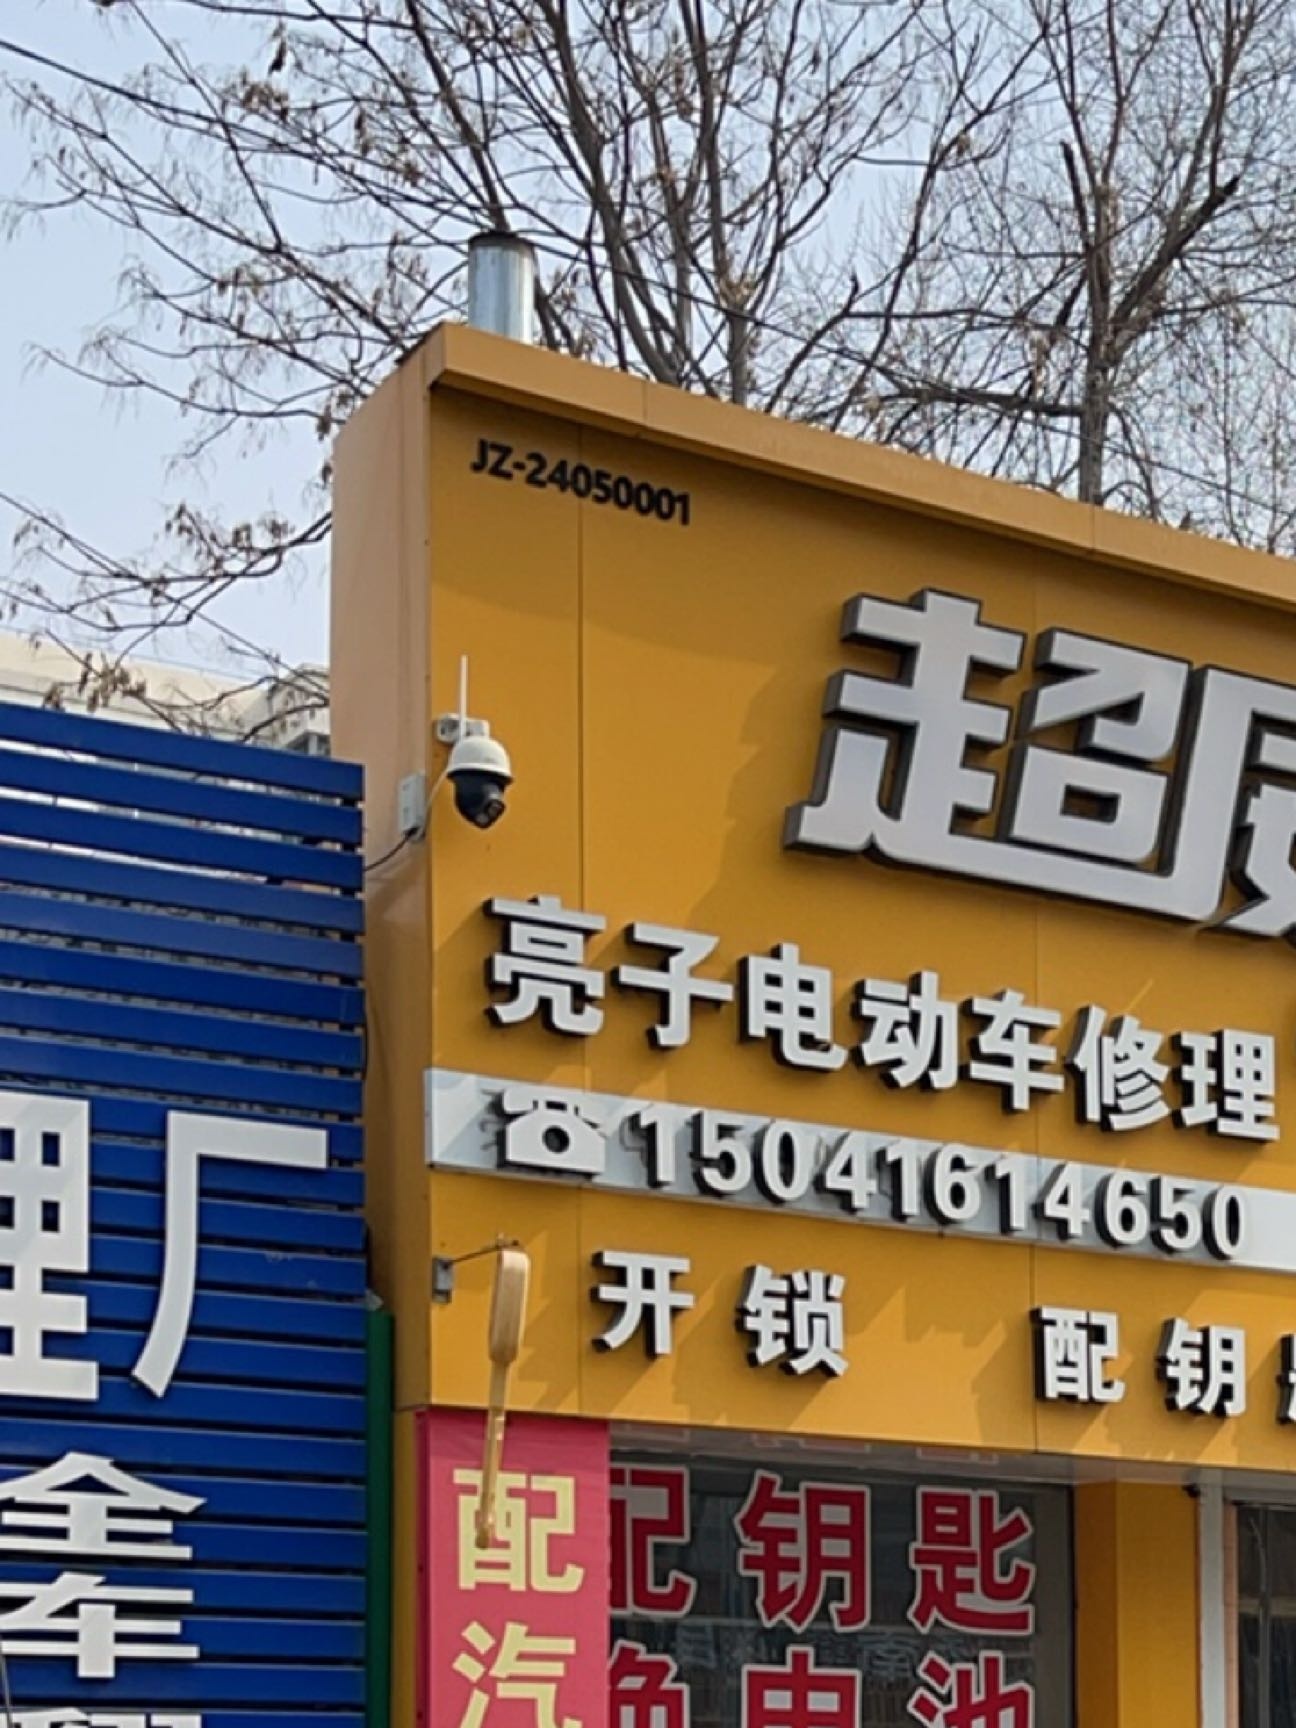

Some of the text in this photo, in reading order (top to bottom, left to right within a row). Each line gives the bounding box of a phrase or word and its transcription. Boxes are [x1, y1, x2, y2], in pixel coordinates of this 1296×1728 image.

[470, 438, 691, 526] JZ-24050001
[487, 896, 1280, 1142] 亮子电动车修理
[636, 1104, 1244, 1262] 15041614650
[598, 1250, 849, 1377] 开锁
